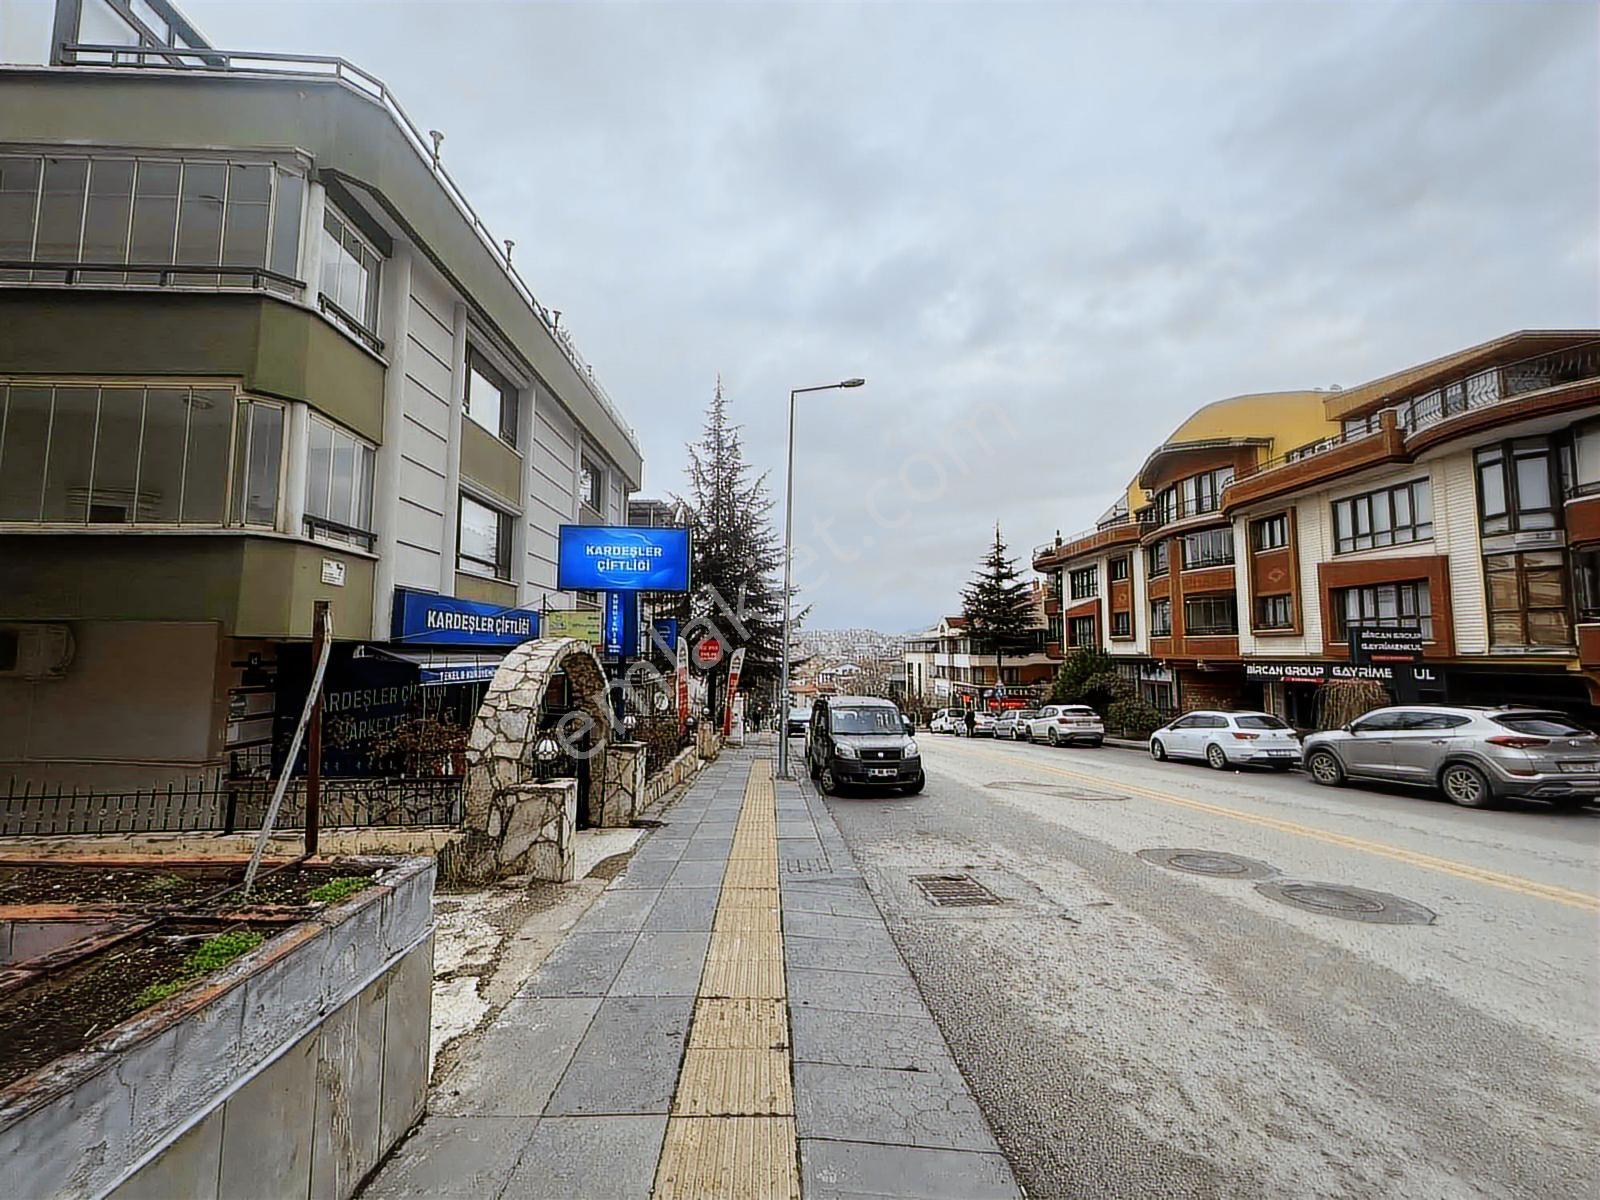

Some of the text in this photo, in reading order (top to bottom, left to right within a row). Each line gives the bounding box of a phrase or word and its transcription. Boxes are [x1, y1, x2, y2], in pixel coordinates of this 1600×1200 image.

[586, 545, 662, 558] KARDEŞLER
[597, 559, 650, 572] ÇİFTLİĞİ
[427, 610, 530, 637] KARDEŞLER ÇİFTLİĞİ
[1246, 663, 1436, 680] BİRCAN GROUP GAYRİMEUL
[319, 685, 399, 713] ARDEŞLER
